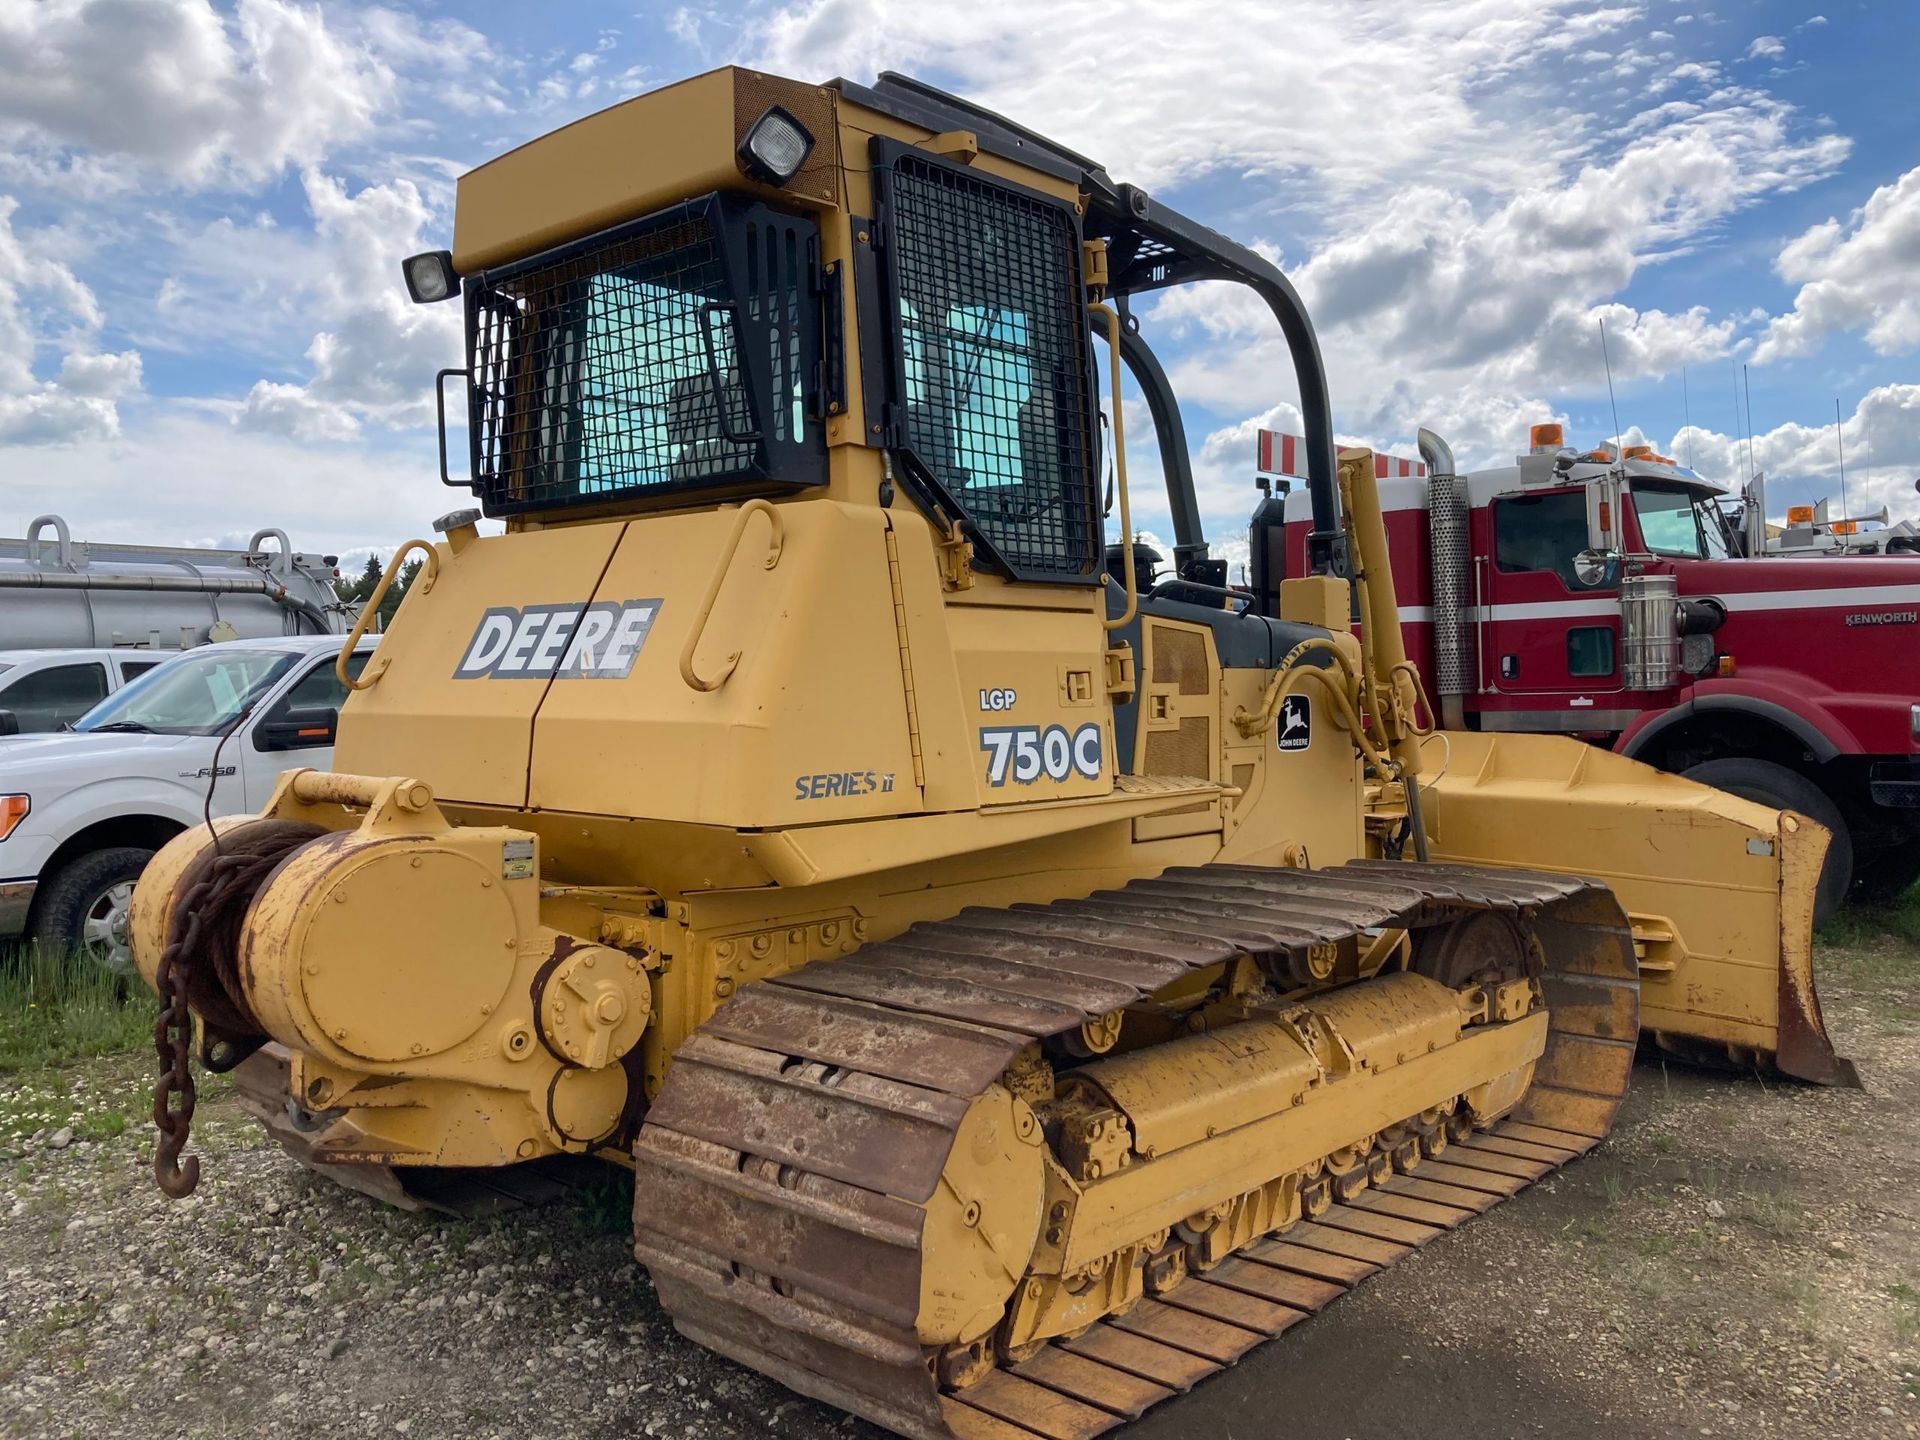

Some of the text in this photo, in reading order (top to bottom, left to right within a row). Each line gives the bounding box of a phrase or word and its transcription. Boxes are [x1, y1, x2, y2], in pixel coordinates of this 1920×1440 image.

[1845, 611, 1917, 625] KENWORTH
[459, 605, 655, 673] DEERE
[980, 689, 1016, 711] LGP
[1280, 738, 1308, 747] JOHN DEERE
[982, 725, 1101, 786] 750C
[795, 772, 895, 800] SERIES II
